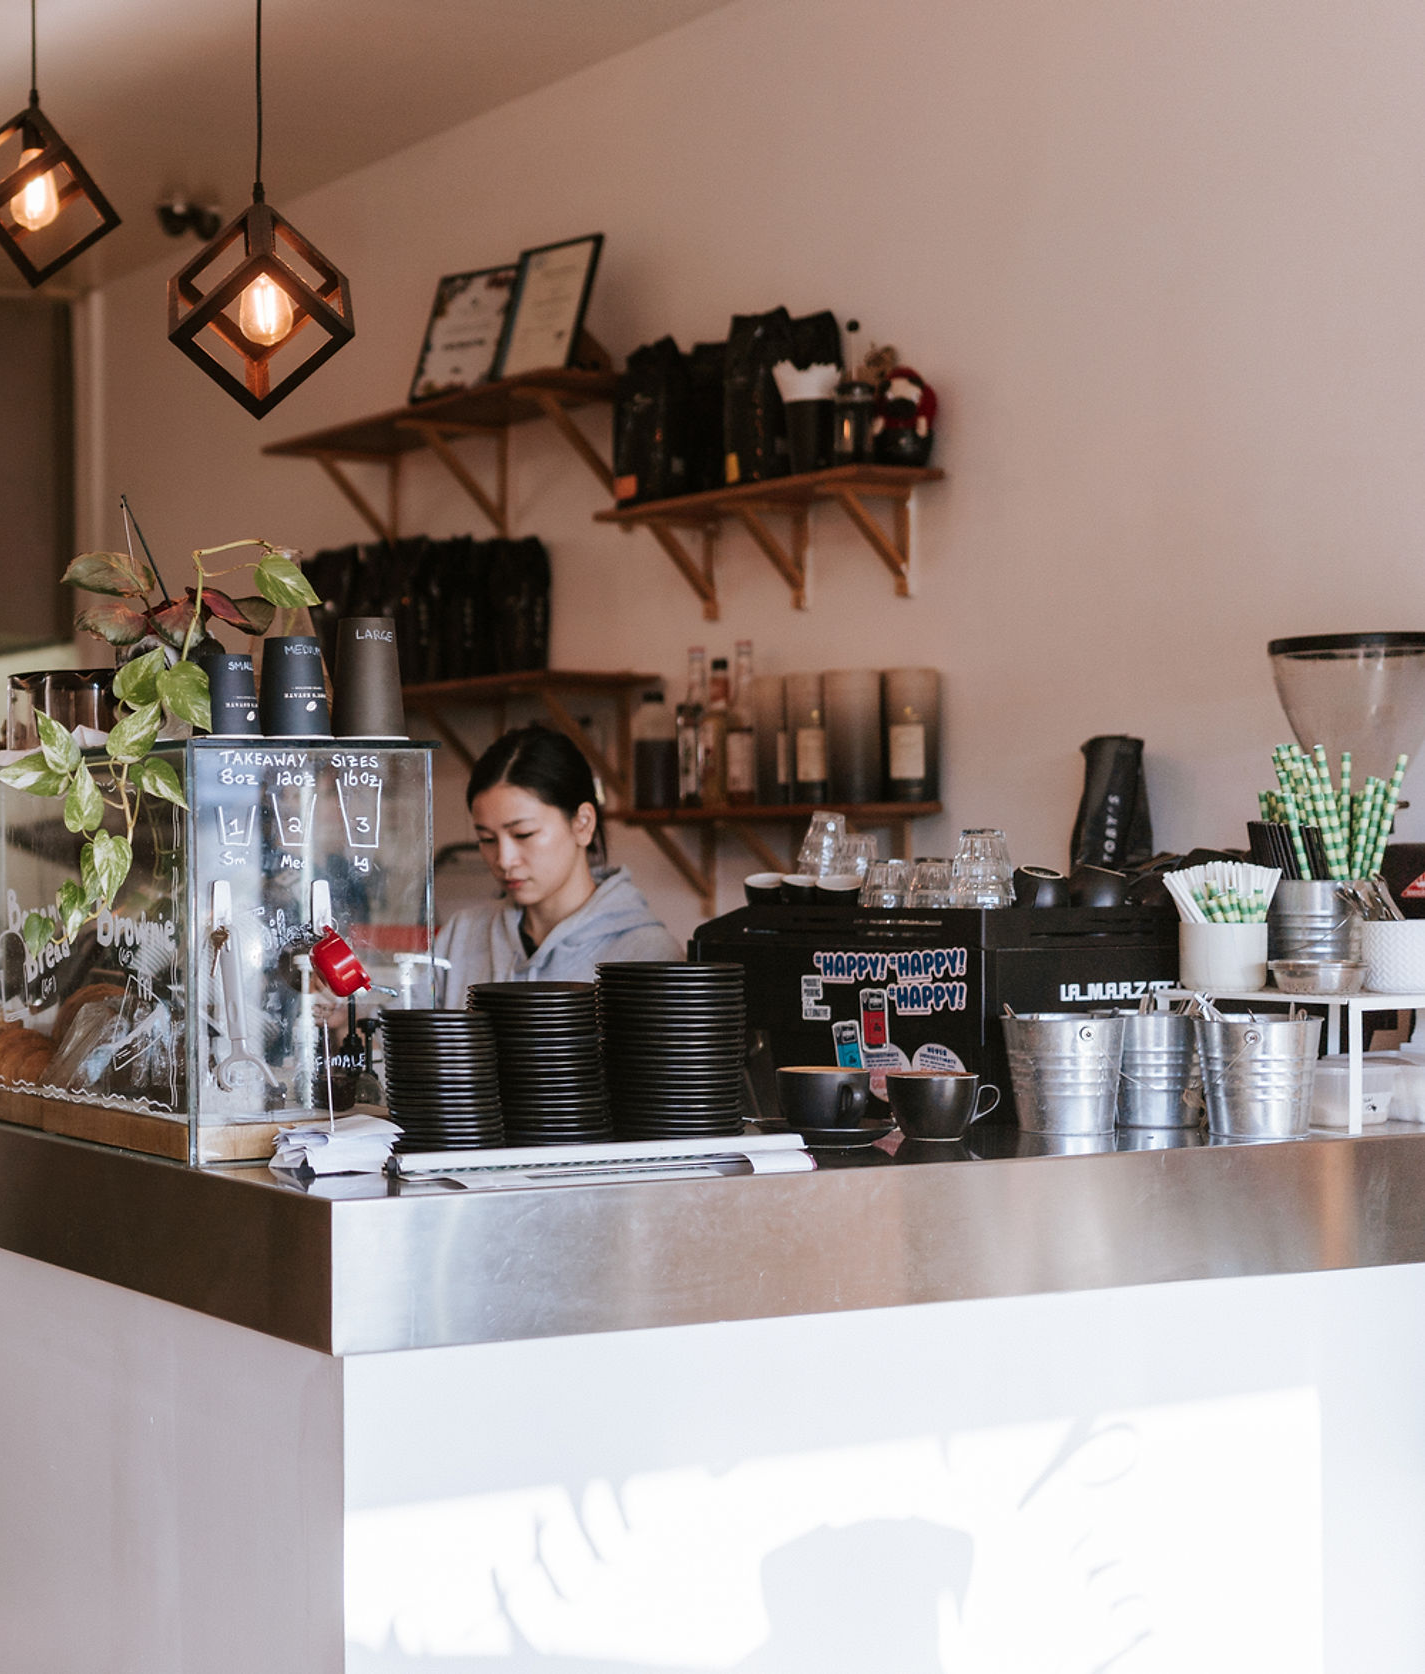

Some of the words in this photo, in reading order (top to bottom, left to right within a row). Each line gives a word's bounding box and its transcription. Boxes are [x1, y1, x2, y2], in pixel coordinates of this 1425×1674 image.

[356, 629, 393, 642] LARGE
[220, 751, 307, 767] TAKEAWAY
[331, 754, 378, 768] SIZES
[229, 818, 244, 836] 1
[288, 817, 303, 833] 2
[356, 816, 371, 833] 3
[815, 953, 887, 979] #HAPPY!
[888, 950, 966, 978] #HAPPY!
[888, 984, 965, 1009] #HAPPY!
[315, 1052, 366, 1073] FMALE
